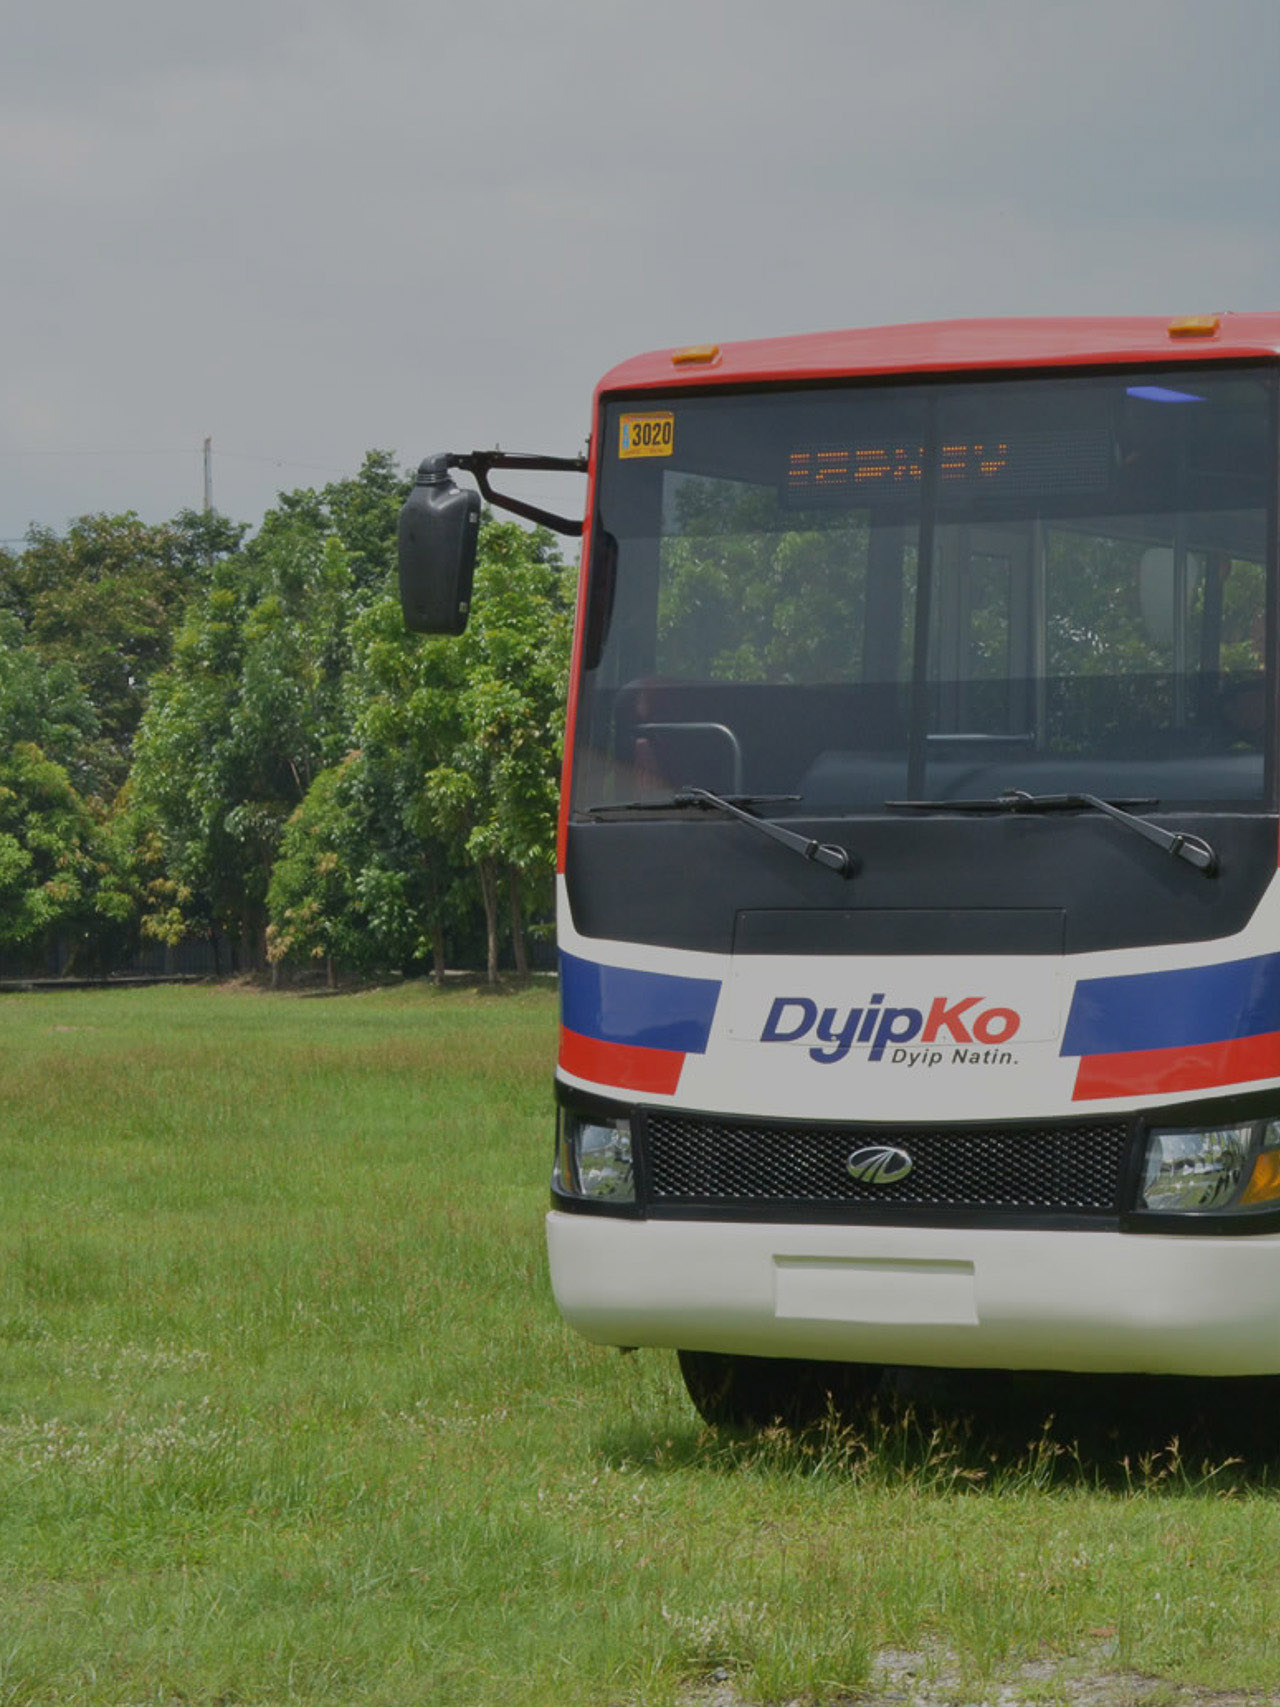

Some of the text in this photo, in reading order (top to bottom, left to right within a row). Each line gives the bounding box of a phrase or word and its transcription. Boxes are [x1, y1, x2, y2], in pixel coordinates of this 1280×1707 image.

[632, 421, 671, 447] 3020
[760, 993, 1021, 1064] DyipKo
[892, 1048, 1019, 1067] Dyip Natin.
